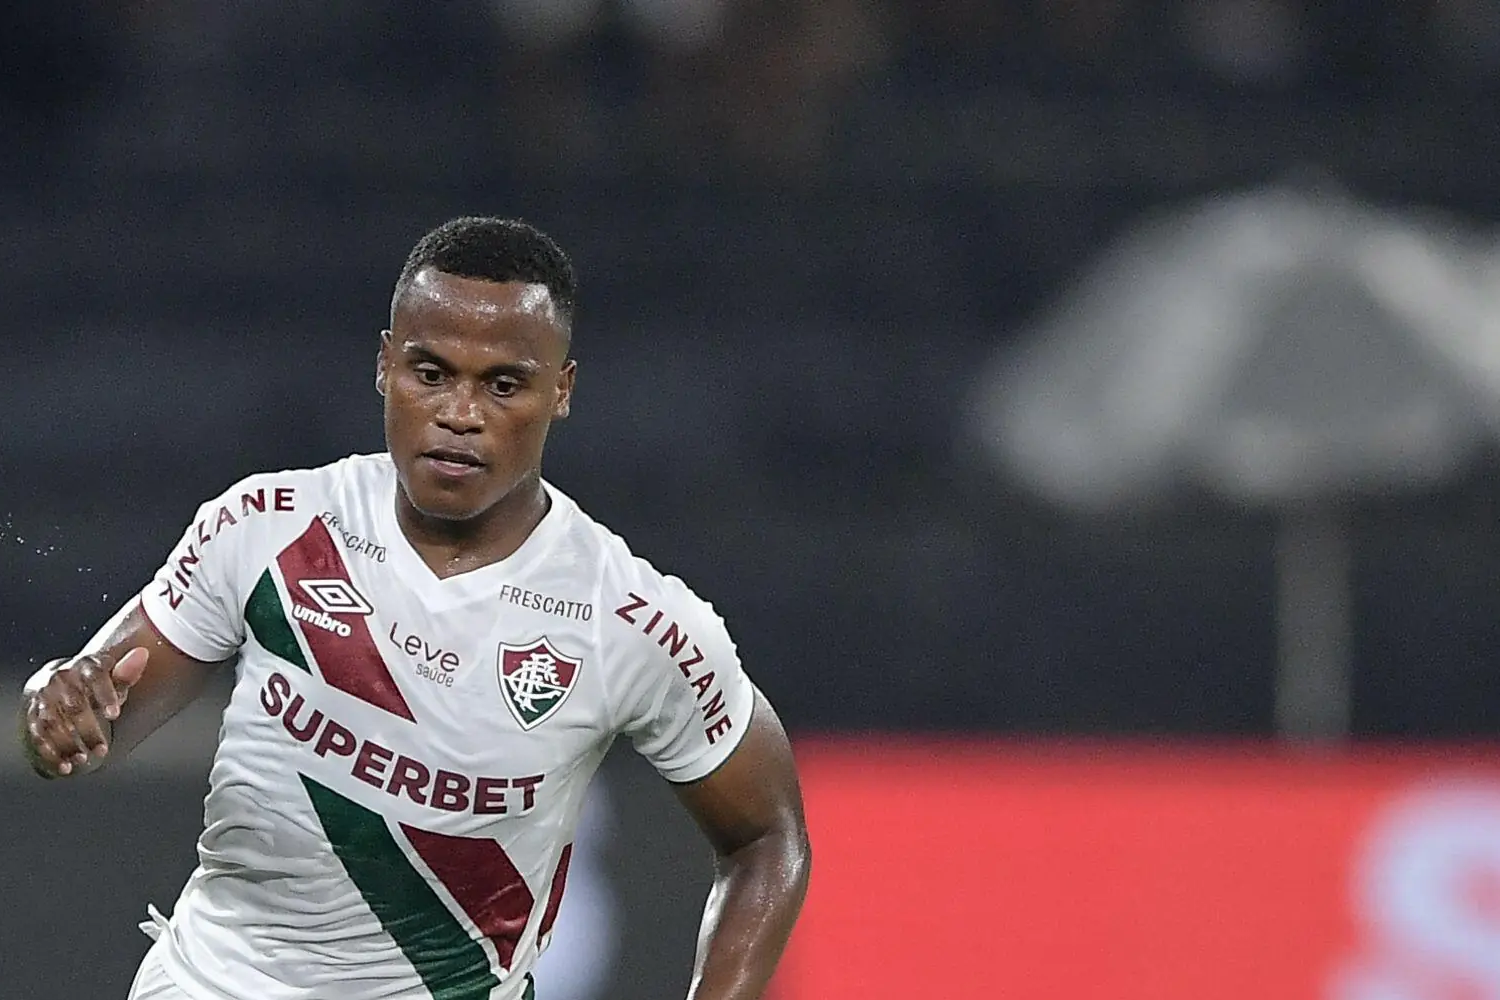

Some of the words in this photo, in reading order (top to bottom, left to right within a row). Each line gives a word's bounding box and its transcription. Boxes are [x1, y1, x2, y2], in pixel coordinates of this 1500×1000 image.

[159, 488, 295, 611] ZINZANE
[320, 511, 387, 563] FRSCATTO
[293, 604, 351, 637] umbro
[499, 584, 593, 622] FRESCATTO
[389, 621, 460, 673] Leve
[615, 592, 732, 745] ZINZANE
[415, 663, 454, 688] saúde
[260, 672, 545, 815] SUPERBET
